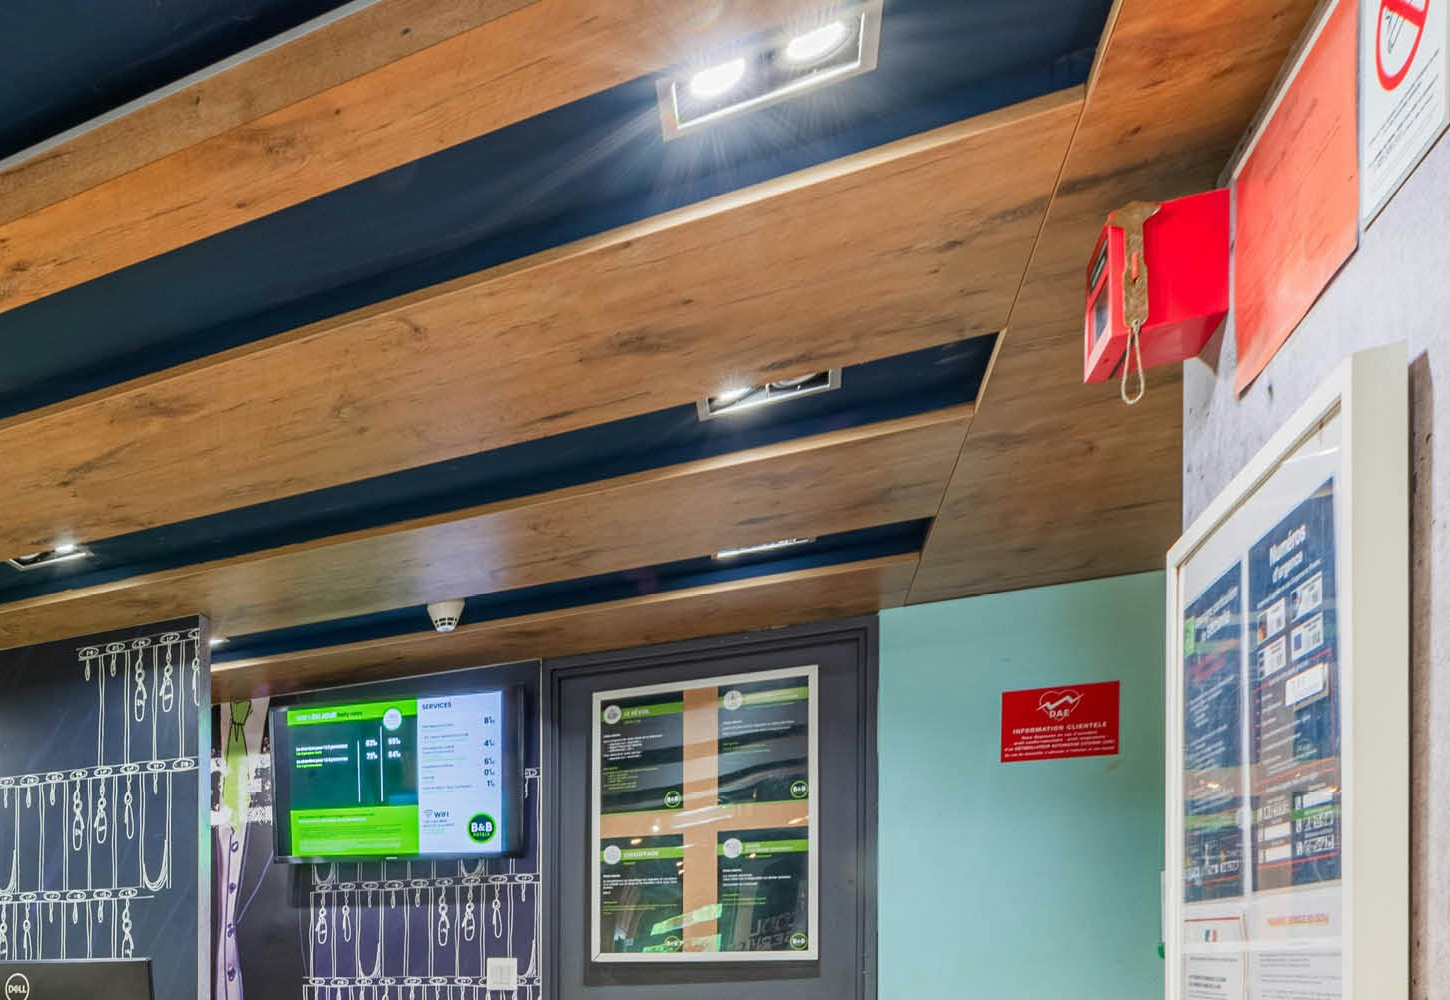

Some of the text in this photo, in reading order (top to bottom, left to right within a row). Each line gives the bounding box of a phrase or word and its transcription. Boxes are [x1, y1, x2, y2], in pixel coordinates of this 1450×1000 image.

[422, 702, 452, 710] SERVICES
[1049, 708, 1070, 719] DAE
[1012, 724, 1064, 735] INFORMATION
[471, 821, 493, 832] B&B
[8, 984, 27, 994] DELL
